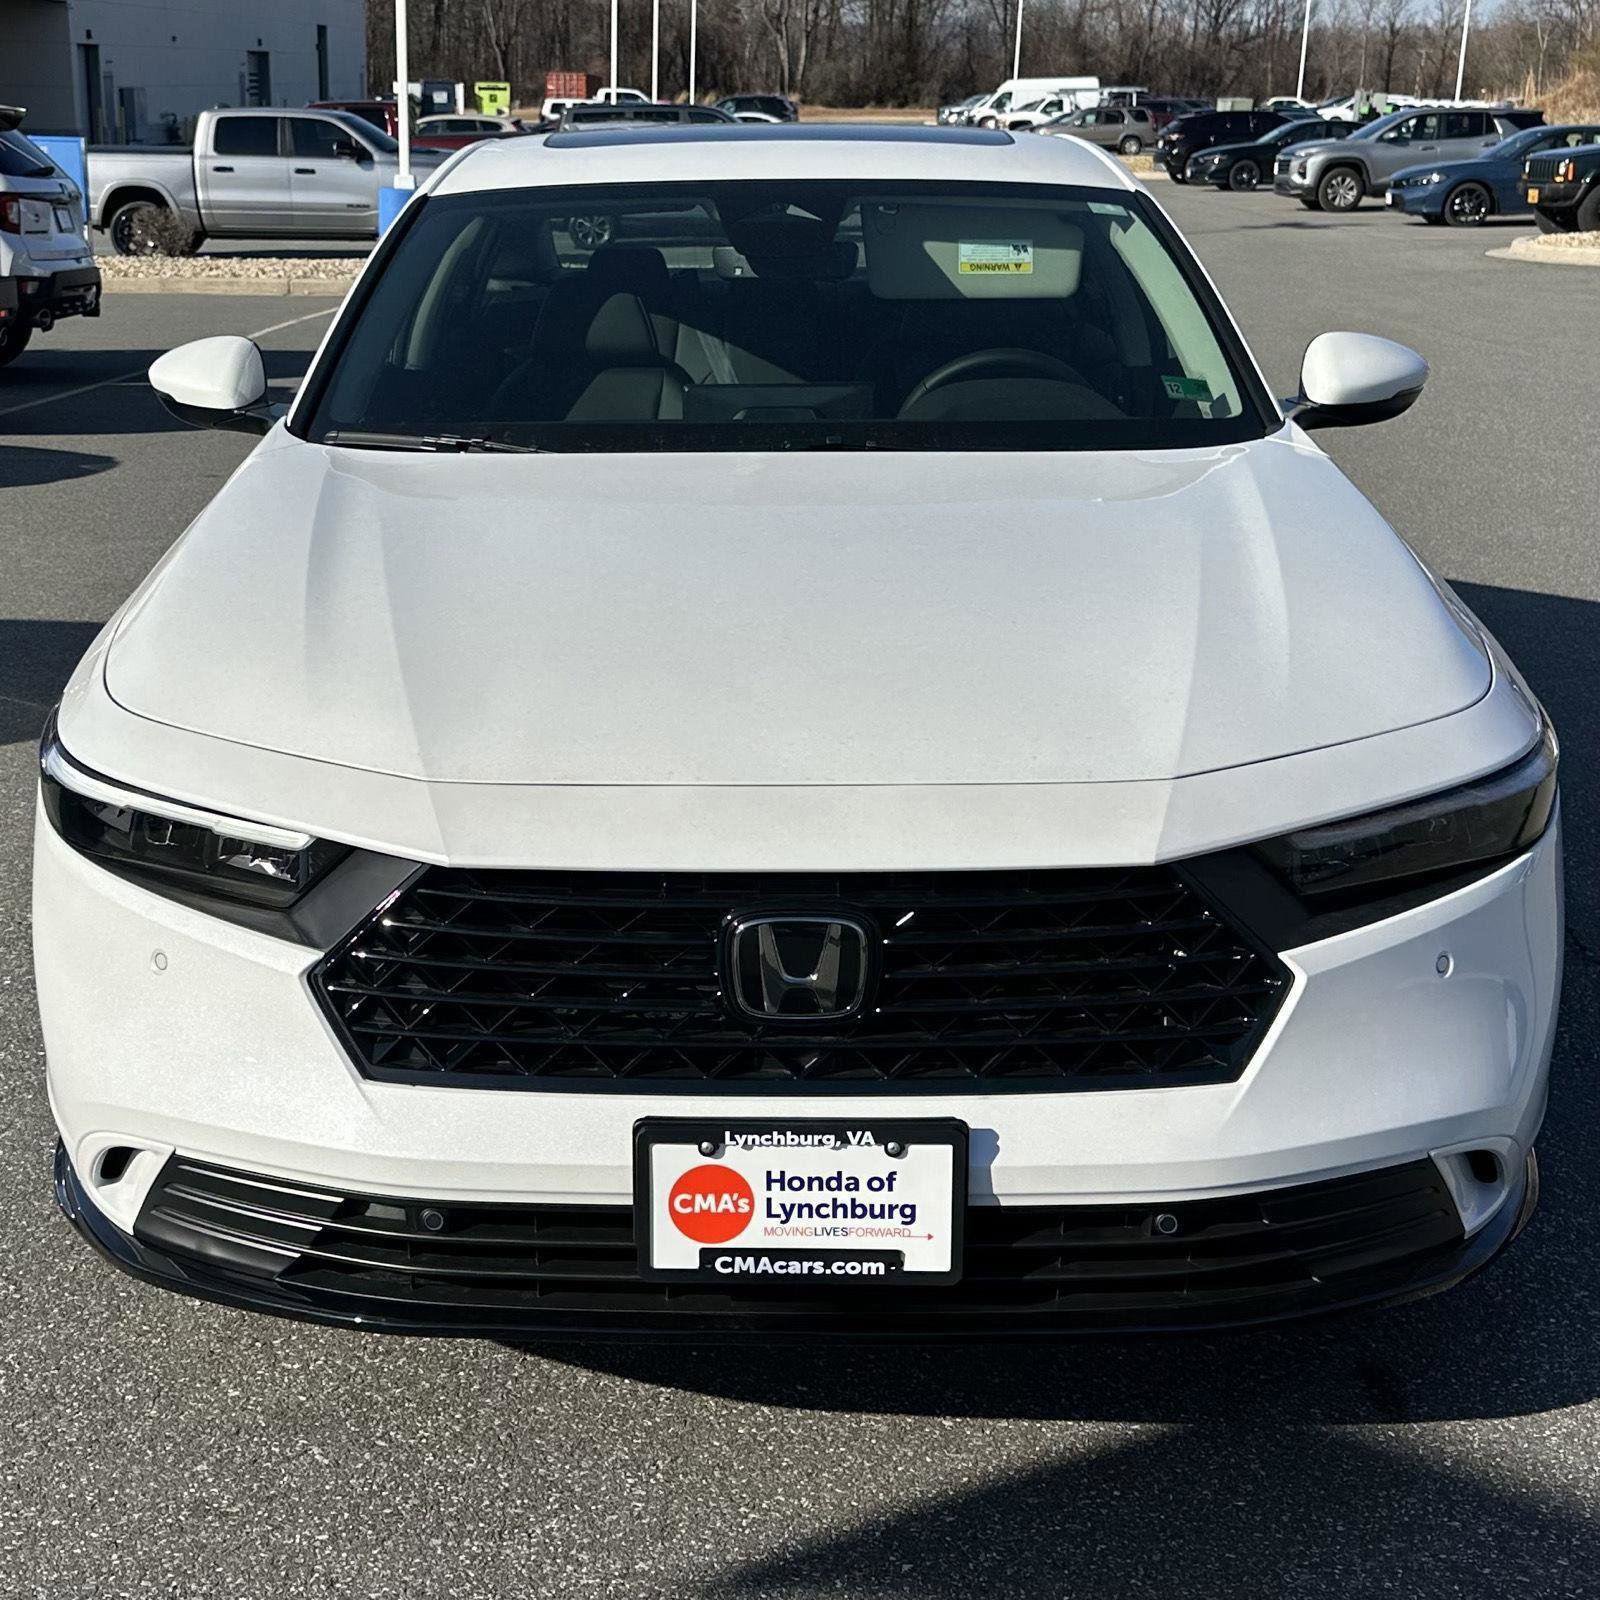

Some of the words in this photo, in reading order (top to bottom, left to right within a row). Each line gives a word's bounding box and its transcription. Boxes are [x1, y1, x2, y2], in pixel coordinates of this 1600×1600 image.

[969, 263, 1011, 272] WARNING
[1167, 383, 1182, 394] 12
[724, 1130, 842, 1148] Lynchburg,
[846, 1131, 875, 1146] VA
[765, 1170, 858, 1192] Honda
[866, 1170, 898, 1192] of
[673, 1193, 751, 1214] CMA's
[765, 1197, 917, 1225] Lynchburg
[714, 1256, 886, 1275] CMAcars.com
